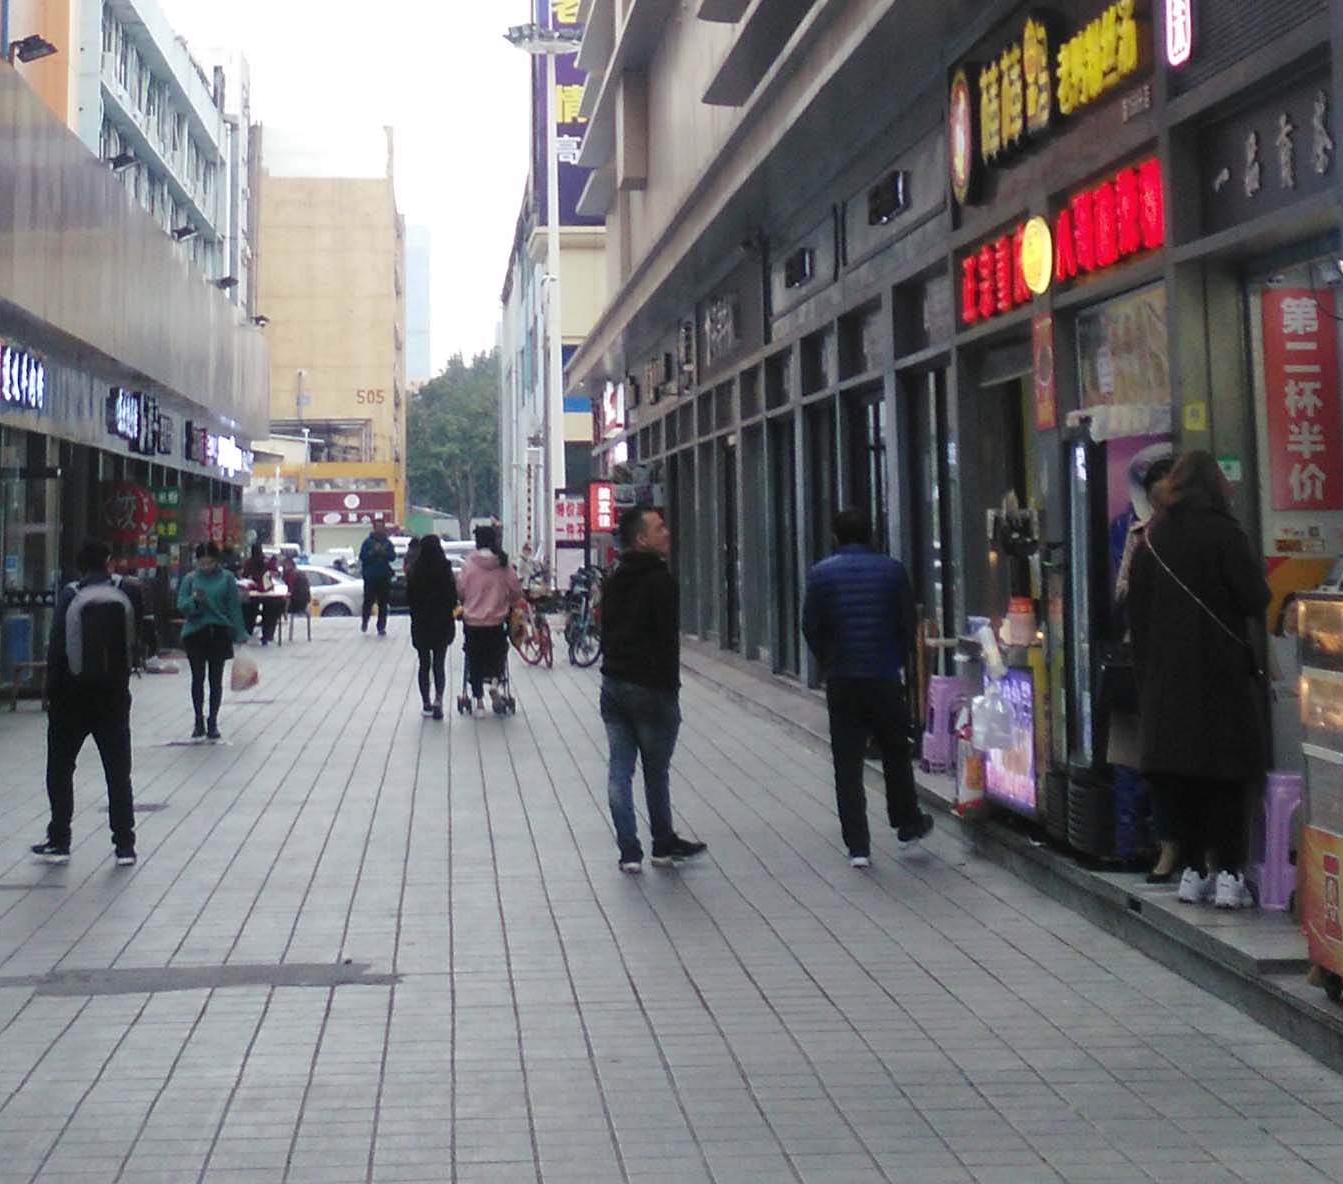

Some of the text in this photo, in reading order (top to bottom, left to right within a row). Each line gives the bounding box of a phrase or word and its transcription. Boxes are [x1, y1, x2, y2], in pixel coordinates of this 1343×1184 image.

[356, 389, 386, 405] 505
[1278, 296, 1328, 502] 第二杯半价
